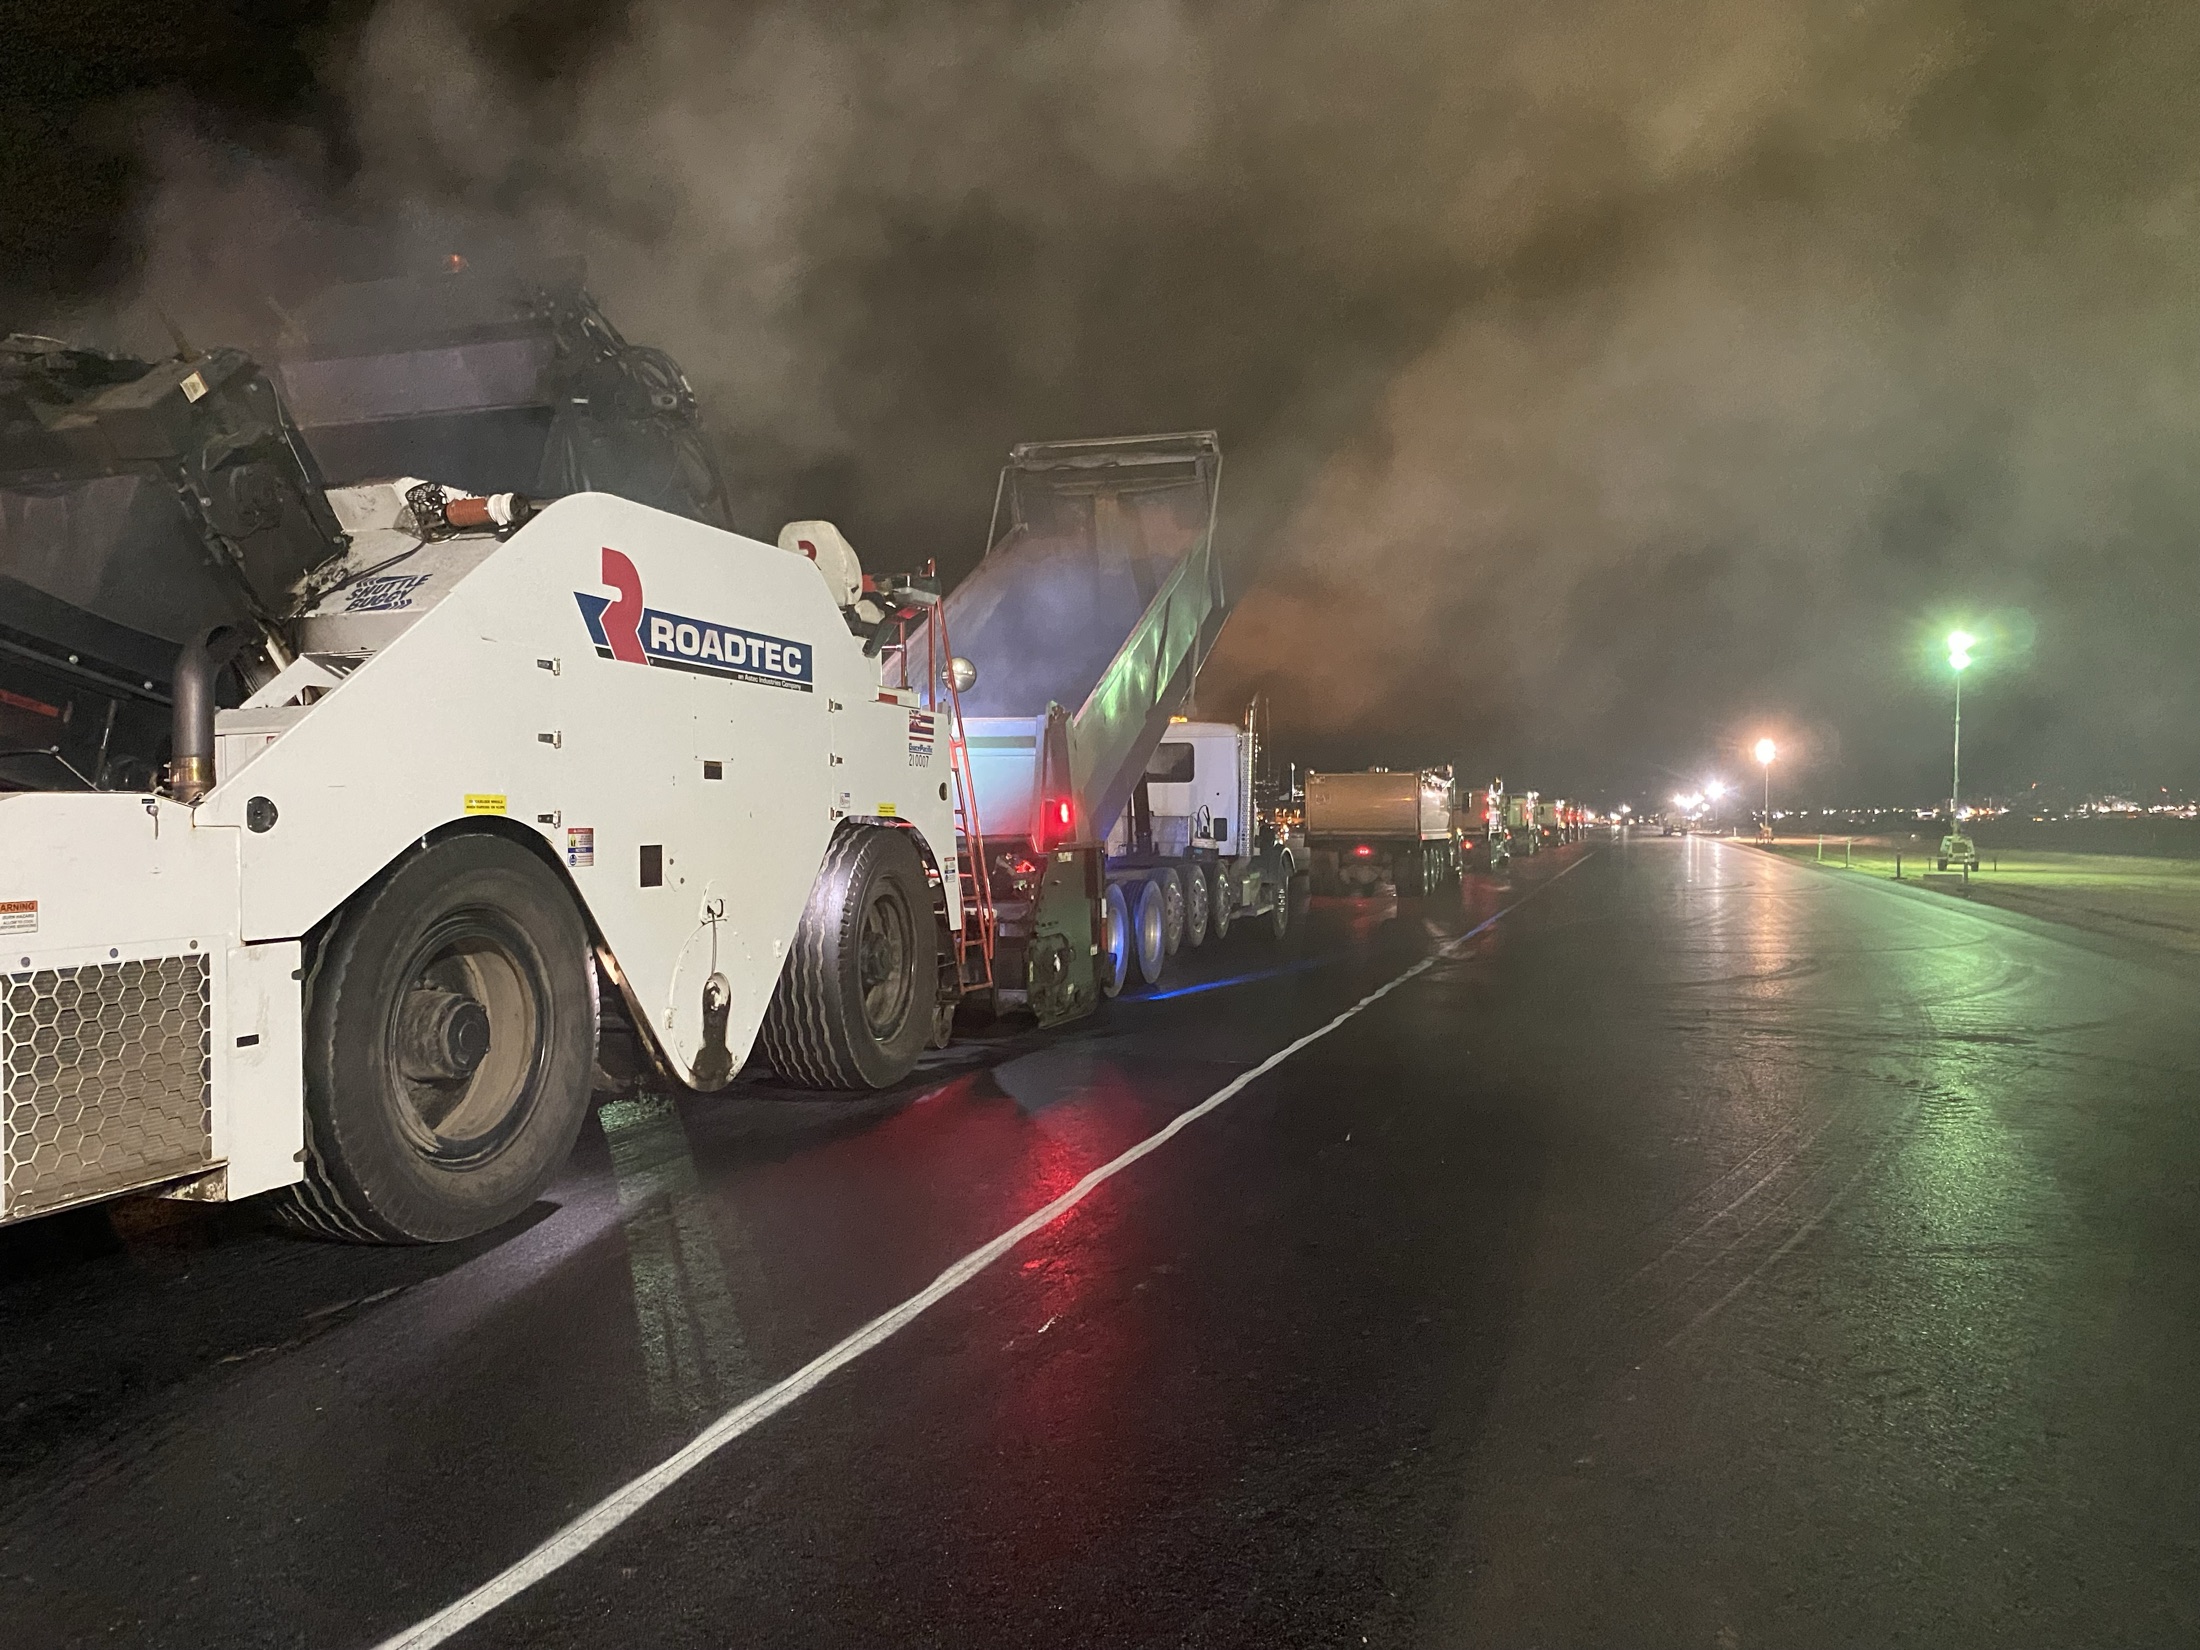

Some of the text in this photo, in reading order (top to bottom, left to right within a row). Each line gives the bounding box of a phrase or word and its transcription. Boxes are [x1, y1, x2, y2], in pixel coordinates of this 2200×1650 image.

[345, 573, 433, 601] SHUTTLE
[344, 587, 416, 611] BUGGY
[650, 616, 802, 676] ROADTEC
[758, 676, 781, 687] Industries
[909, 754, 929, 768] 210007
[0, 902, 34, 911] ARNING
